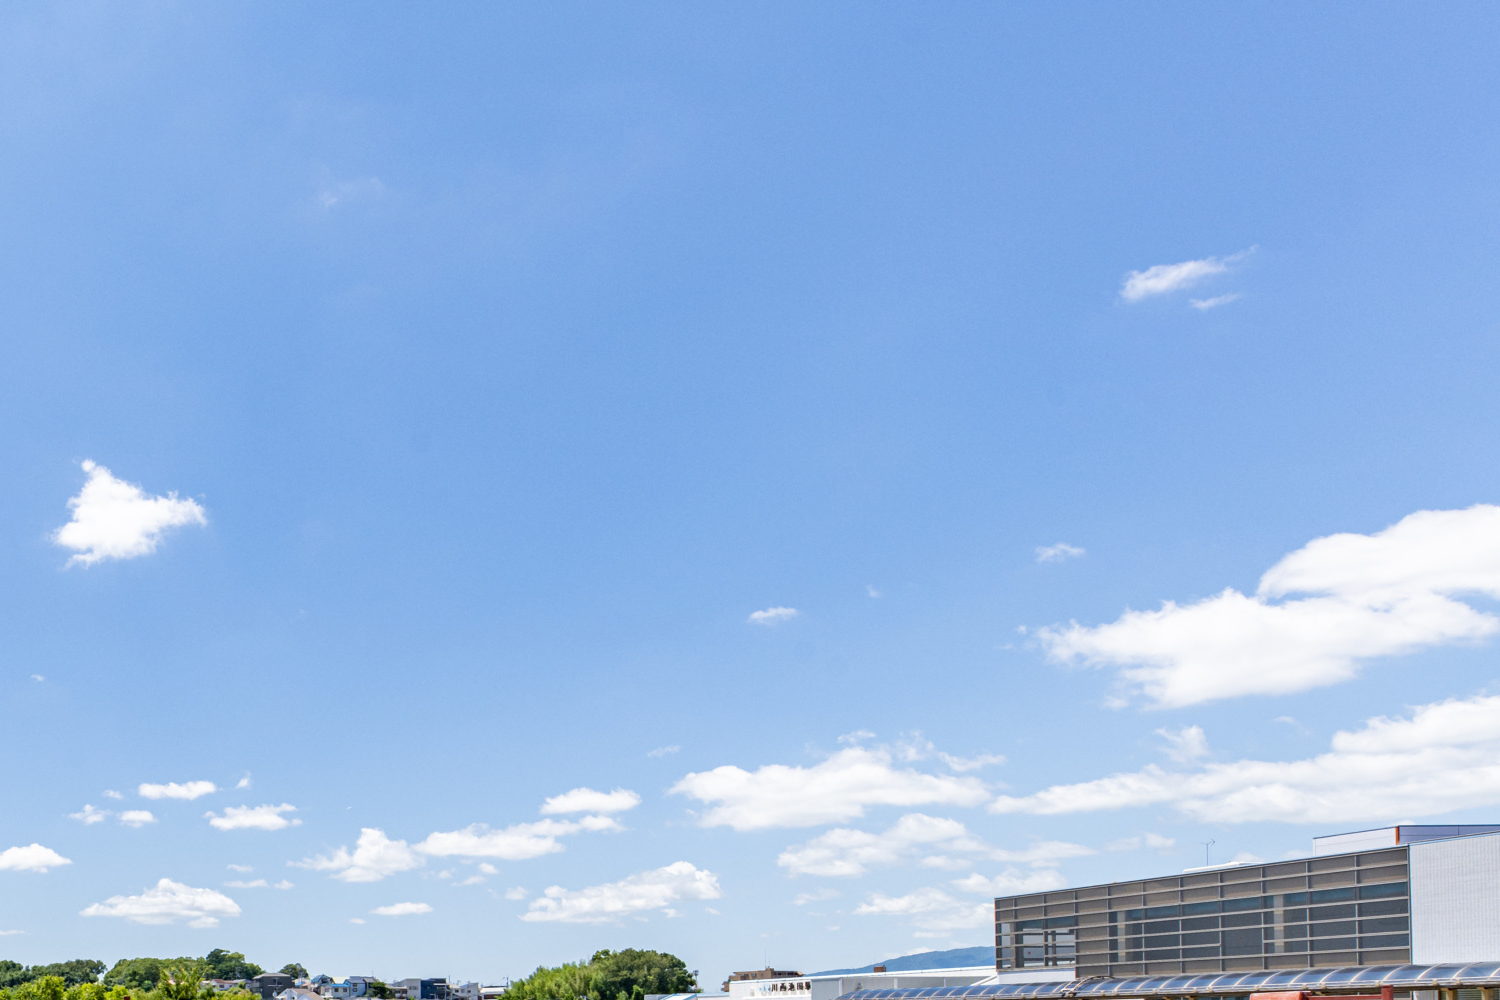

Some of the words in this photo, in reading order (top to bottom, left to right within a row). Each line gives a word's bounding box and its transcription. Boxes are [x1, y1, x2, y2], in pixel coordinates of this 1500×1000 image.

[771, 981, 811, 992] 川西池田駅
